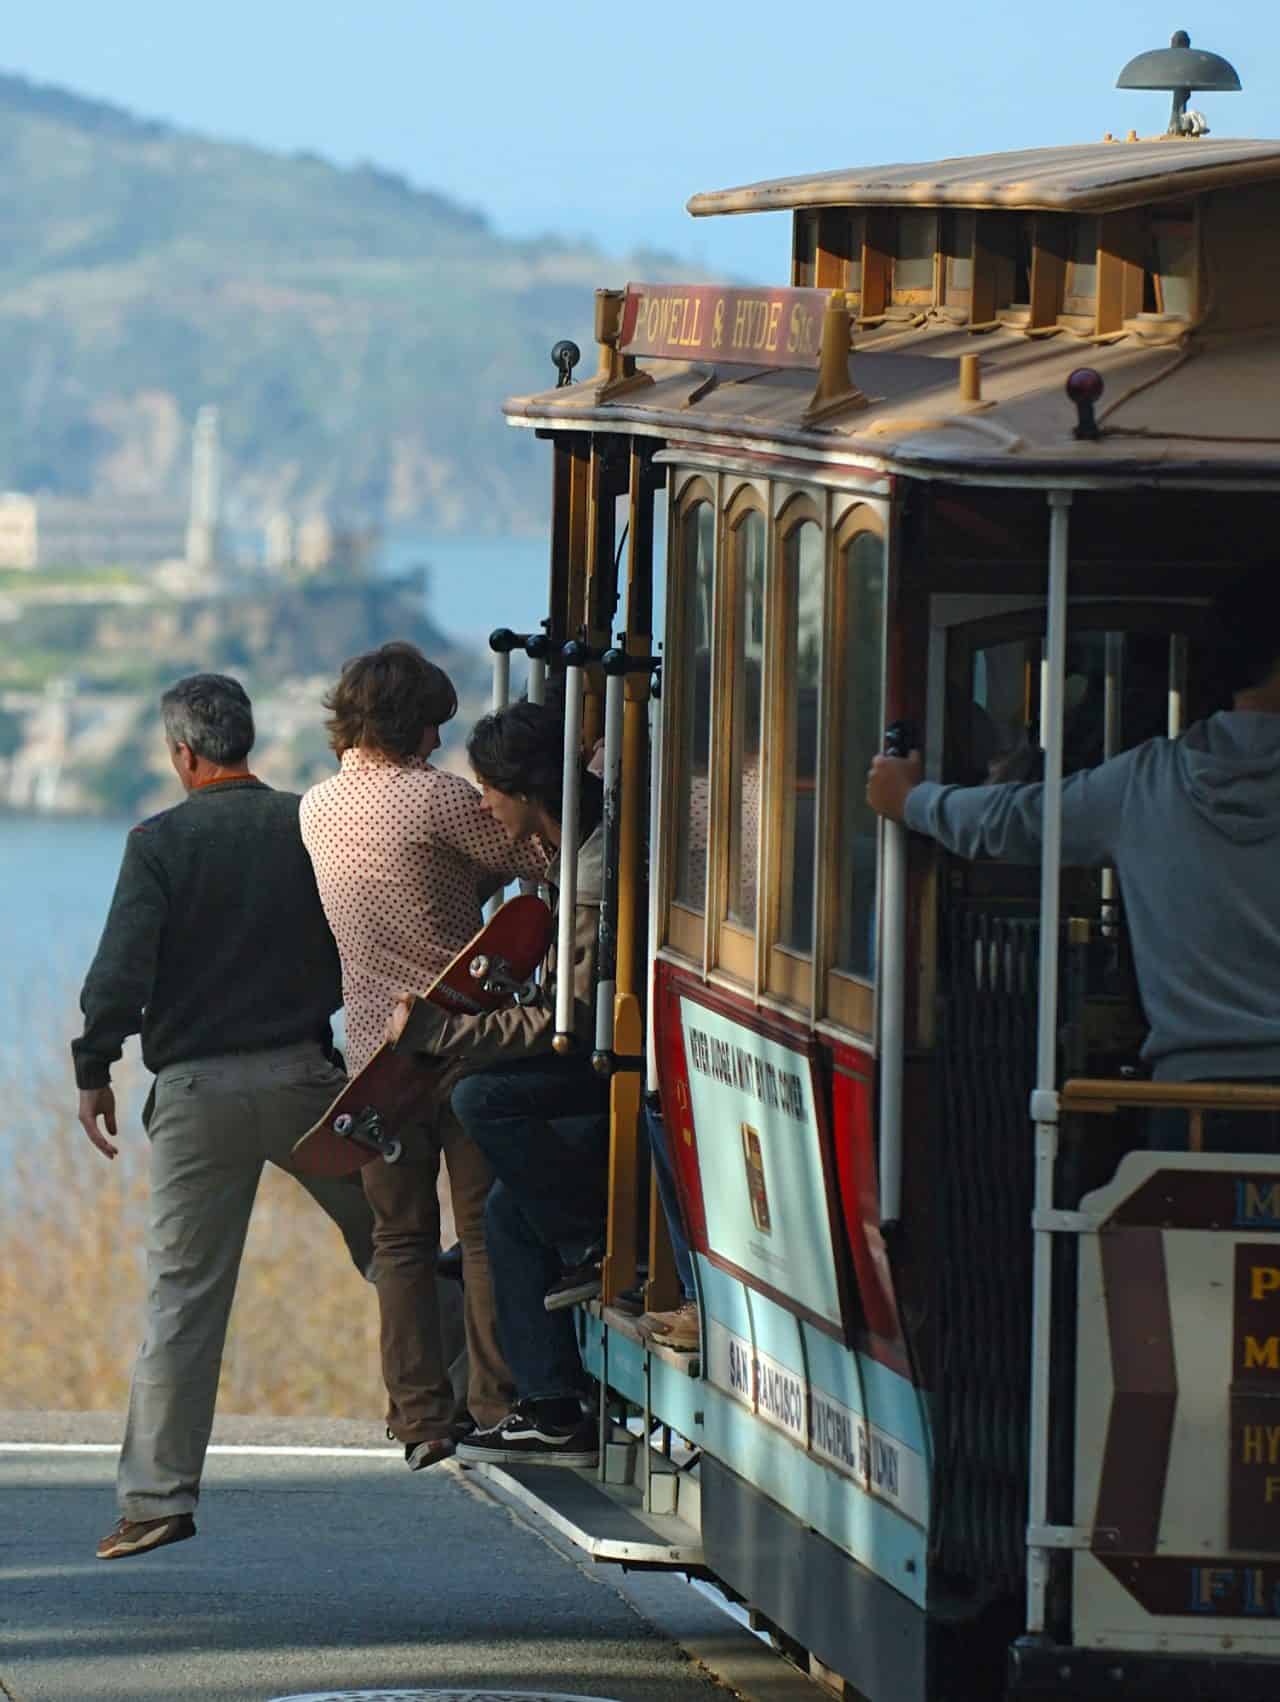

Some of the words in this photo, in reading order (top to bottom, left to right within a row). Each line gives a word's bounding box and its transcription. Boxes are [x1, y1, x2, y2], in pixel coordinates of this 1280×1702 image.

[635, 296, 702, 346] POWELL
[711, 298, 724, 349] &
[732, 300, 783, 351] HYDE
[729, 1339, 750, 1396] SAN
[755, 1356, 802, 1433] RANCISCO
